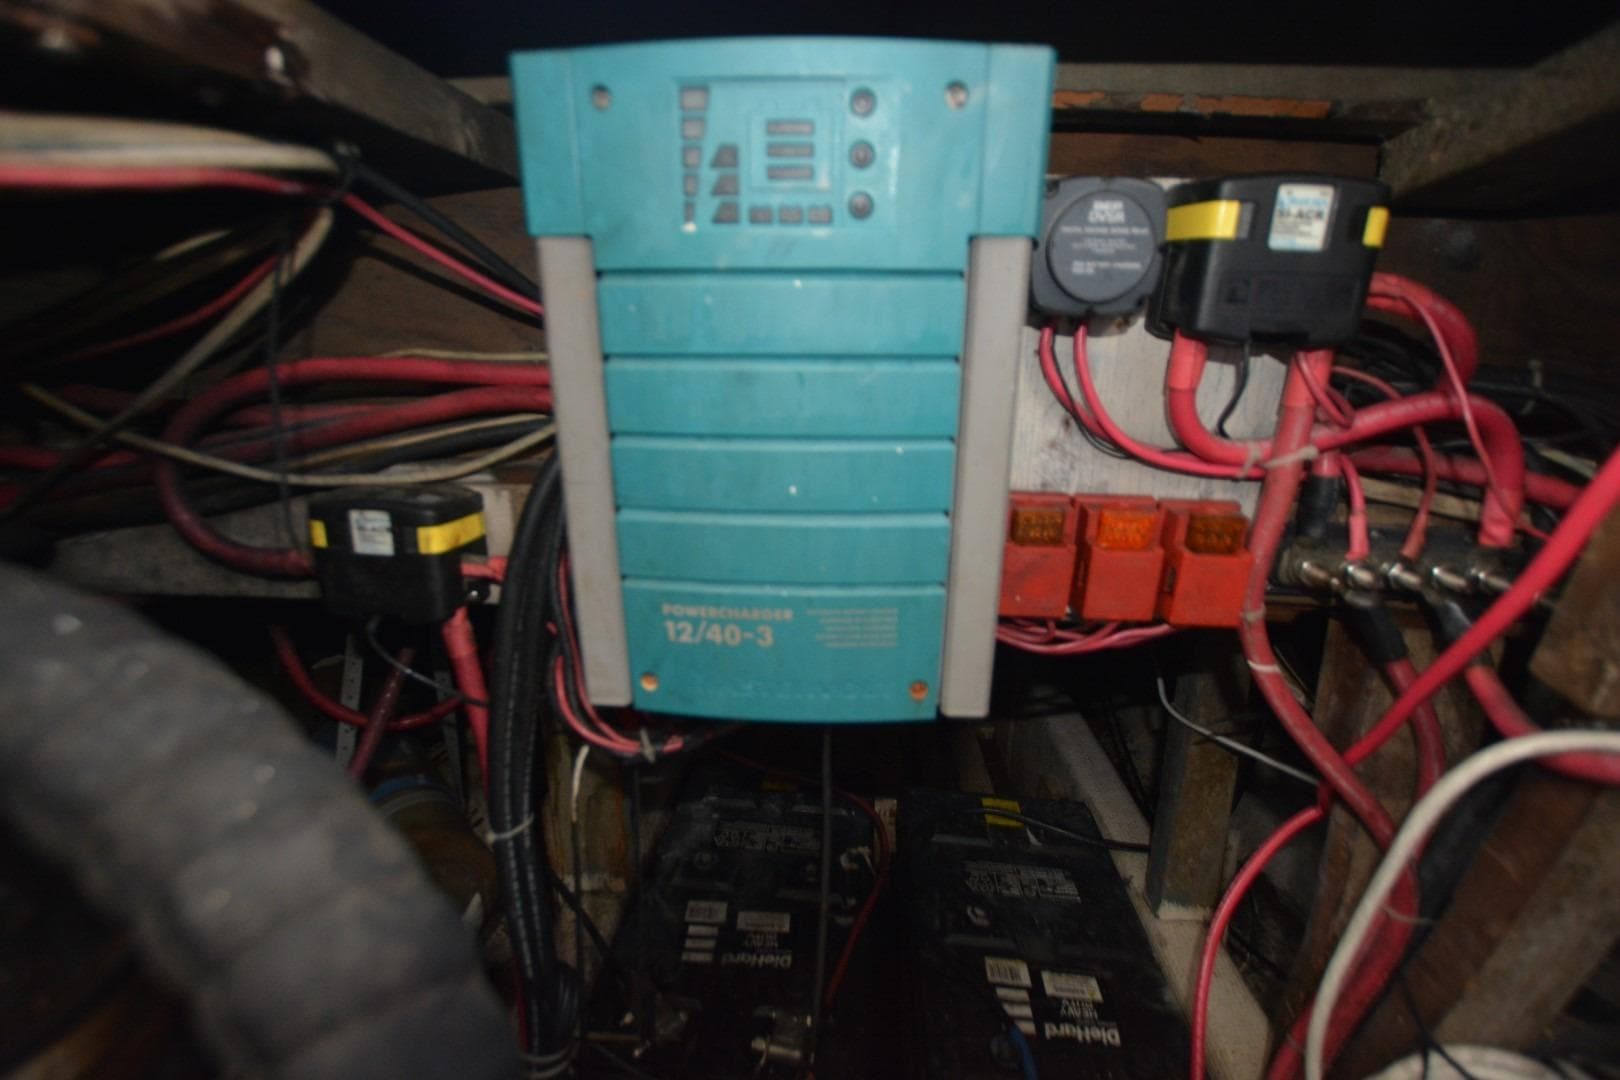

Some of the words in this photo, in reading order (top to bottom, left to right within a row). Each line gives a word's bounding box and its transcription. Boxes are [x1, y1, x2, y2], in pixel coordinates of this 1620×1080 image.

[662, 603, 793, 621] POWERCHARGER
[665, 620, 773, 647] 12/40-3
[720, 951, 793, 969] DieHard
[1044, 1022, 1122, 1046] DieHard
